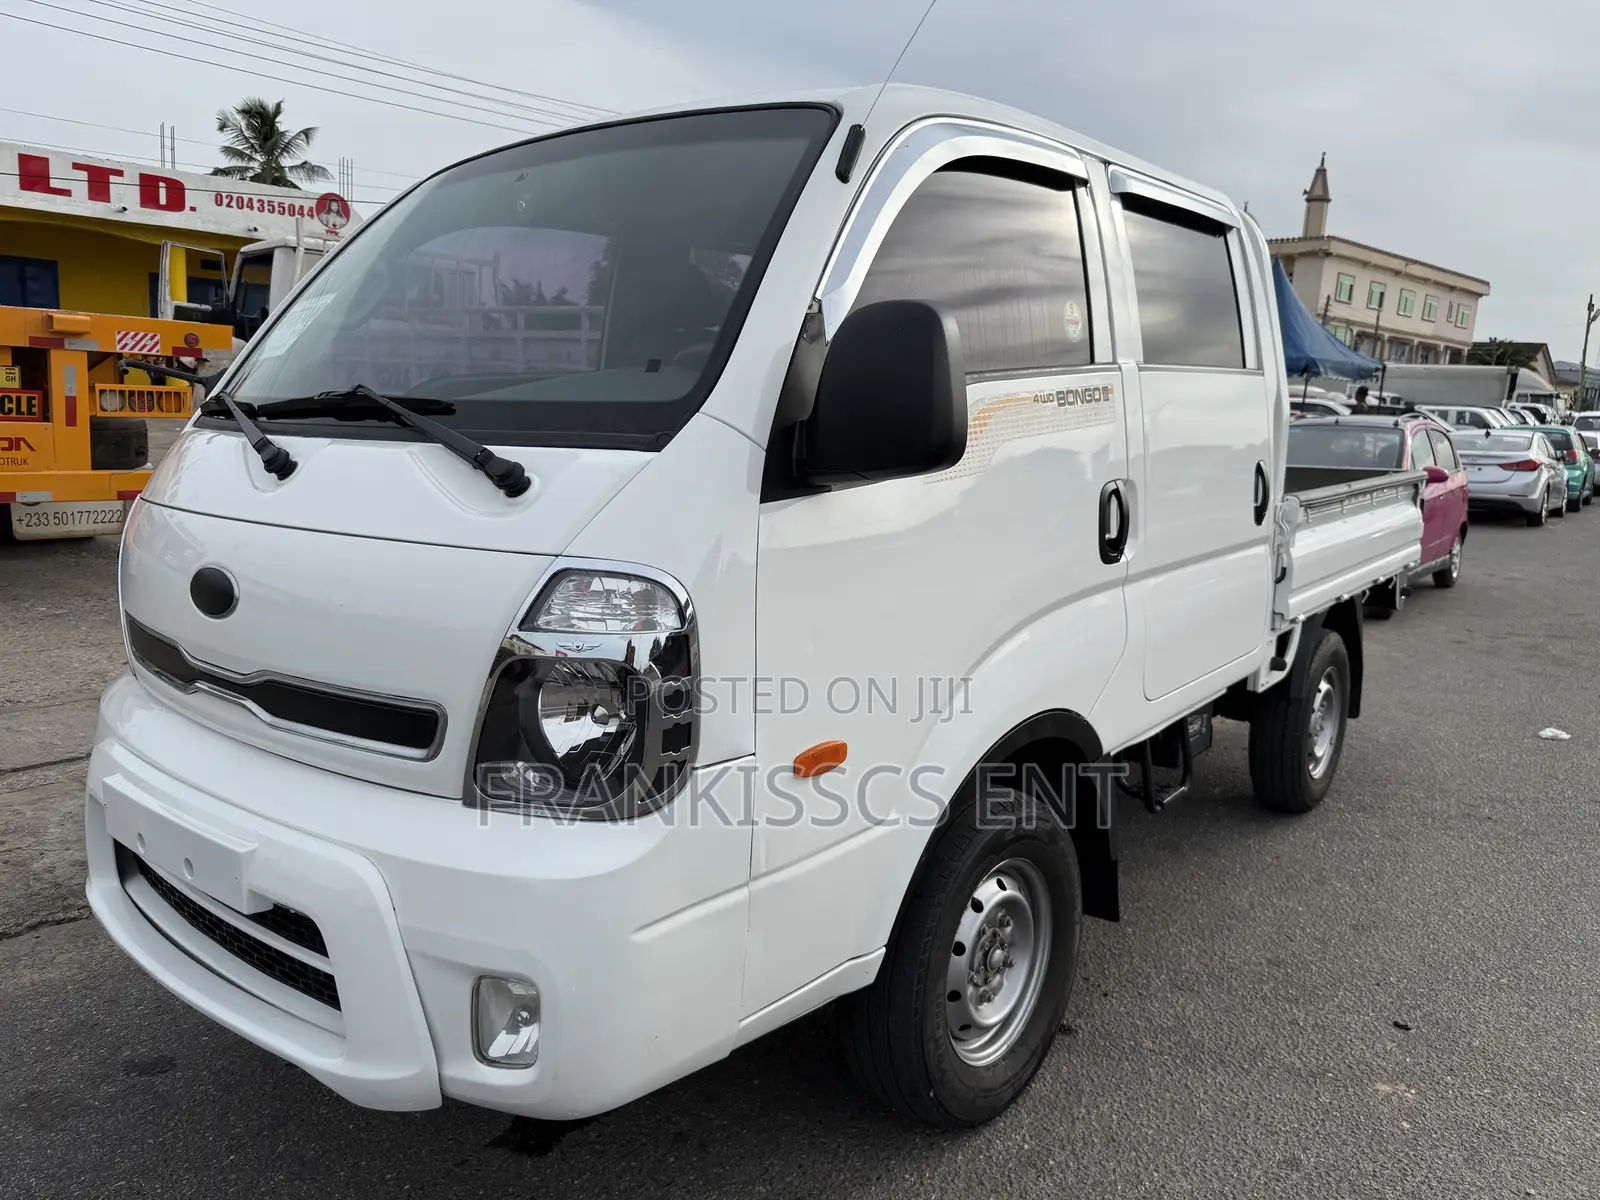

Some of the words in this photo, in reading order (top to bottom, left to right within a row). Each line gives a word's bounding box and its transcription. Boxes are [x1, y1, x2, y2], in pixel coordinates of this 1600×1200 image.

[17, 152, 197, 212] LTD.
[214, 192, 315, 220] 0204355044
[0, 394, 37, 416] CLE
[1056, 387, 1102, 407] BONGO
[16, 512, 50, 528] +233
[53, 509, 123, 526] 501772222
